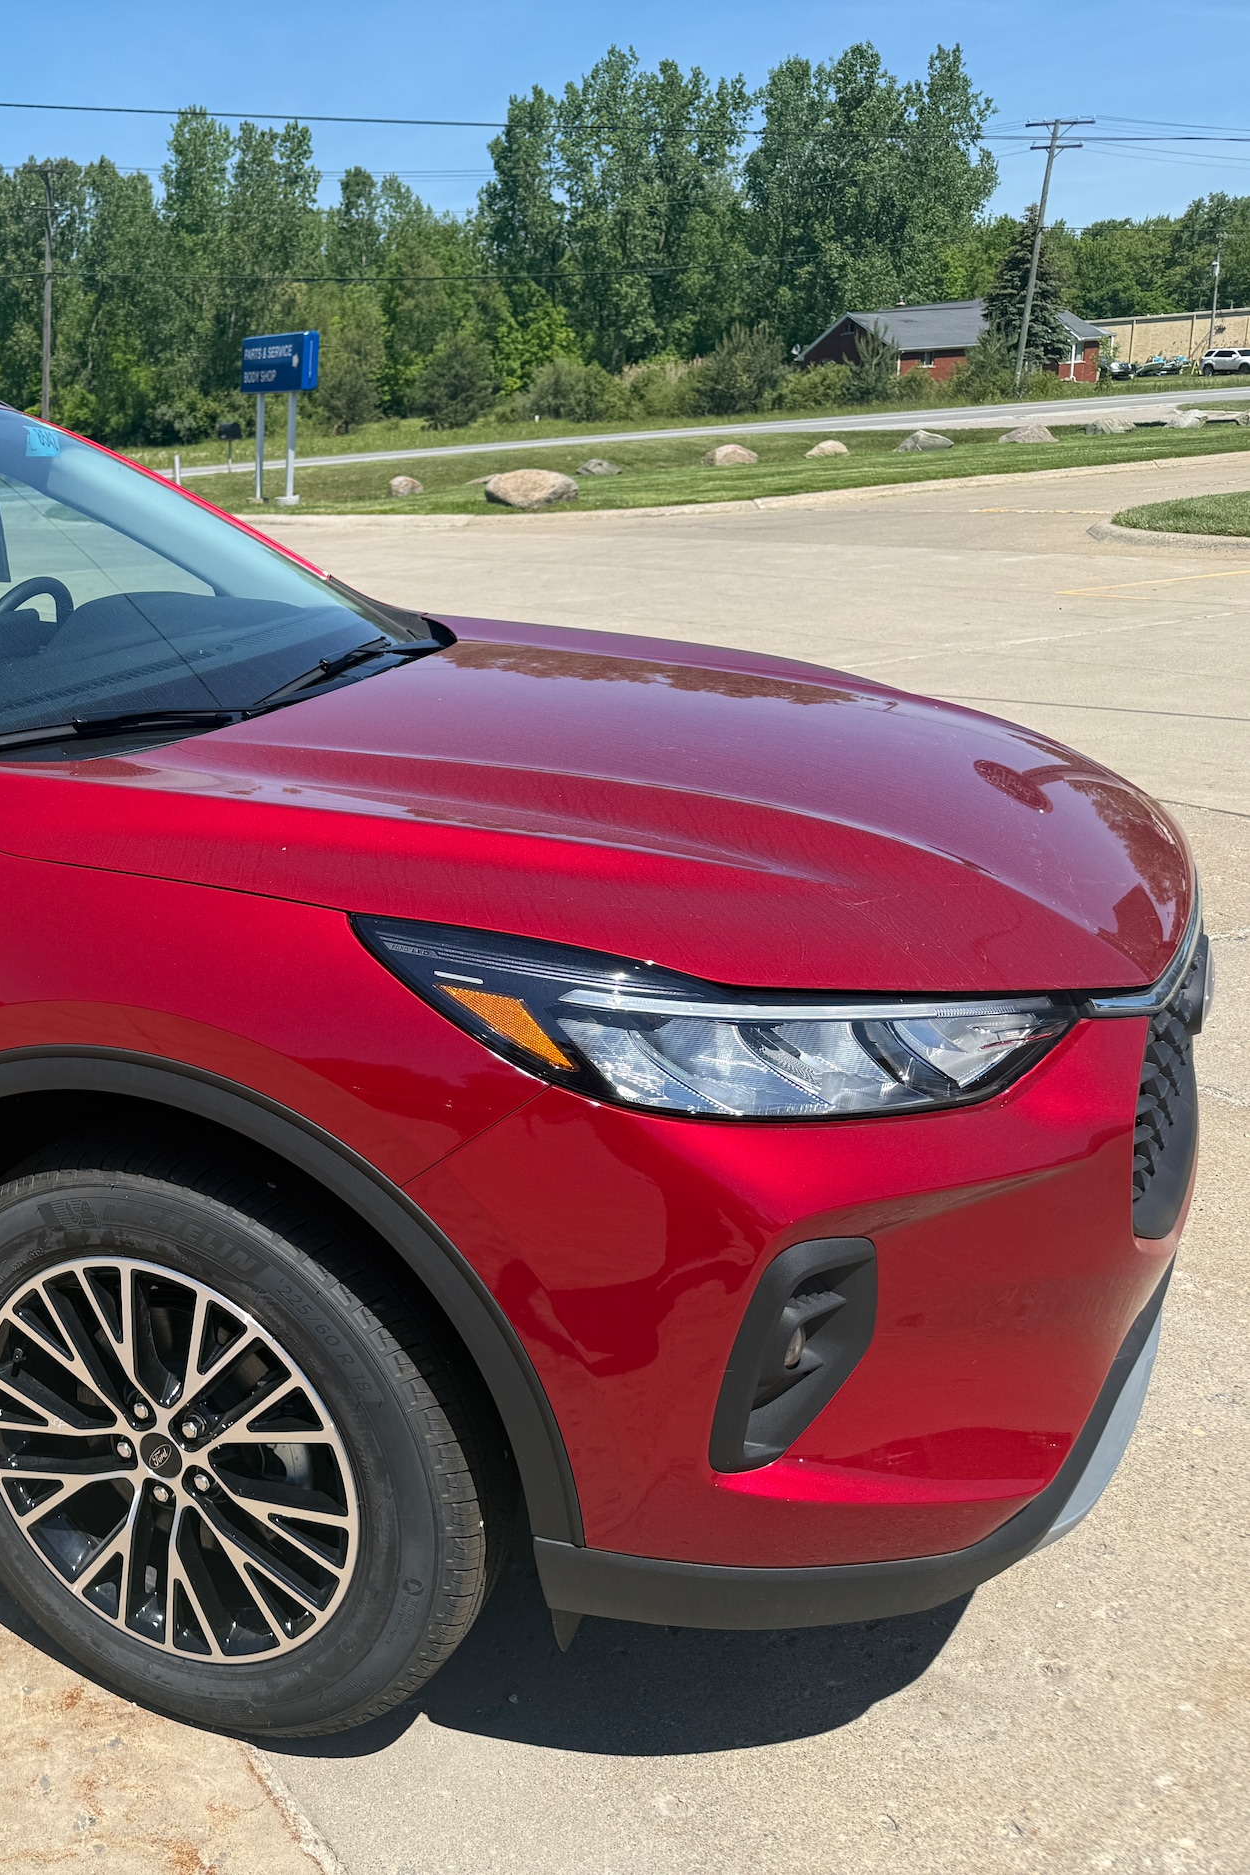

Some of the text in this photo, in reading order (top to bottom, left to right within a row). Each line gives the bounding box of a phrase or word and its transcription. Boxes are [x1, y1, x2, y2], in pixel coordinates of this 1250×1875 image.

[244, 348, 262, 360] PARTS
[267, 345, 292, 358] SERVICE
[243, 369, 277, 383] BODY SHOP
[102, 1202, 257, 1274] MICHELIN
[276, 1285, 372, 1393] 225/60 R 18
